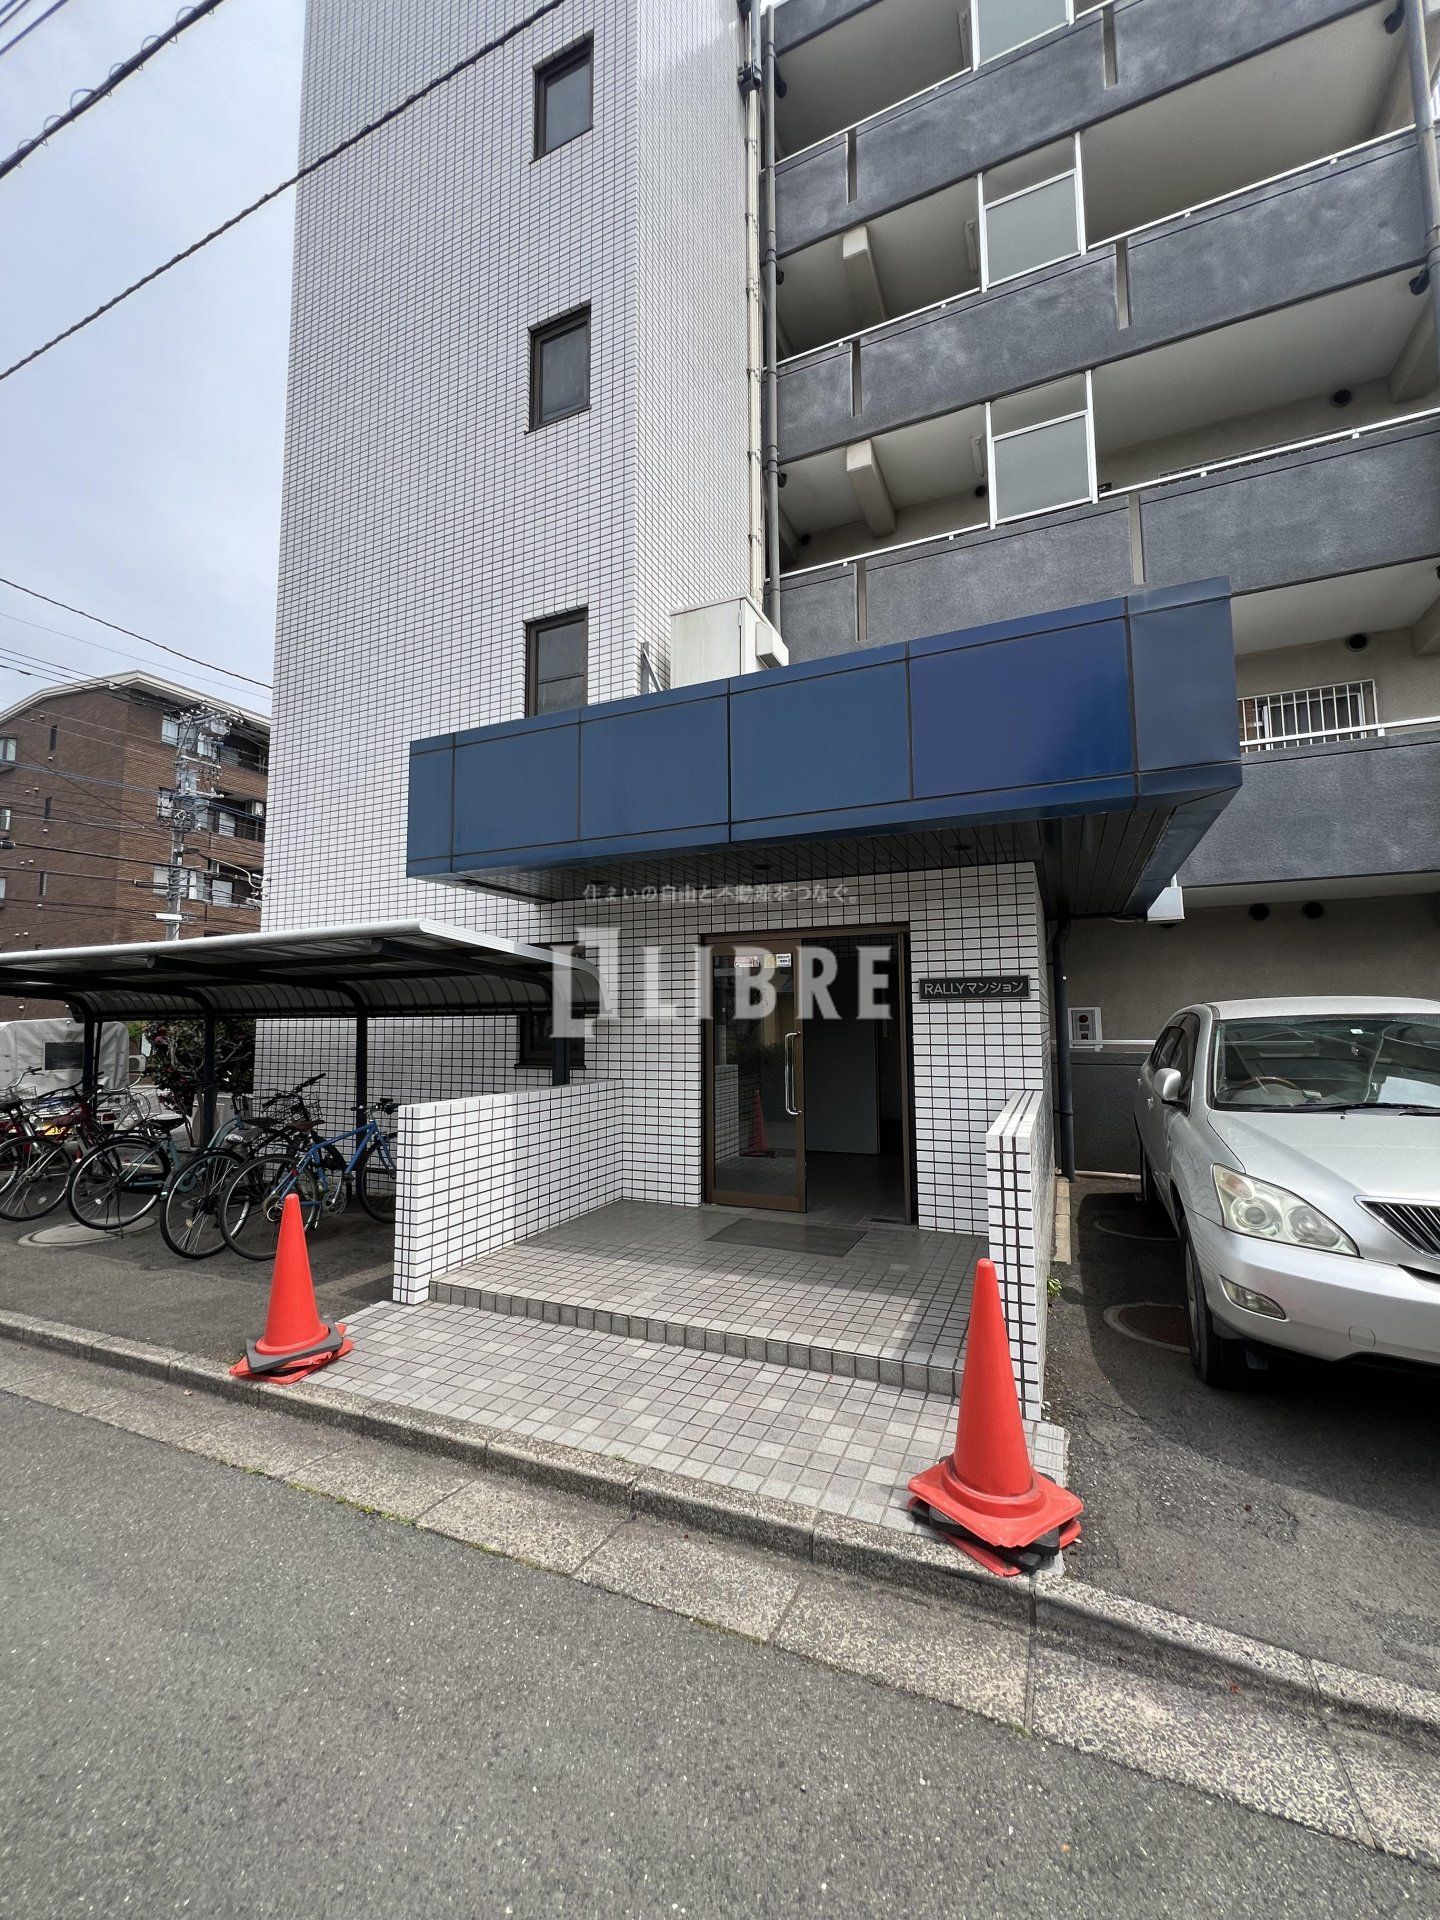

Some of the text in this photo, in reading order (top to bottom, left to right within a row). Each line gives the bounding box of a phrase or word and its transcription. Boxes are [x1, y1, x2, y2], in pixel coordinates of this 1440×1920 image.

[924, 981, 1024, 995] RALLYマンション
